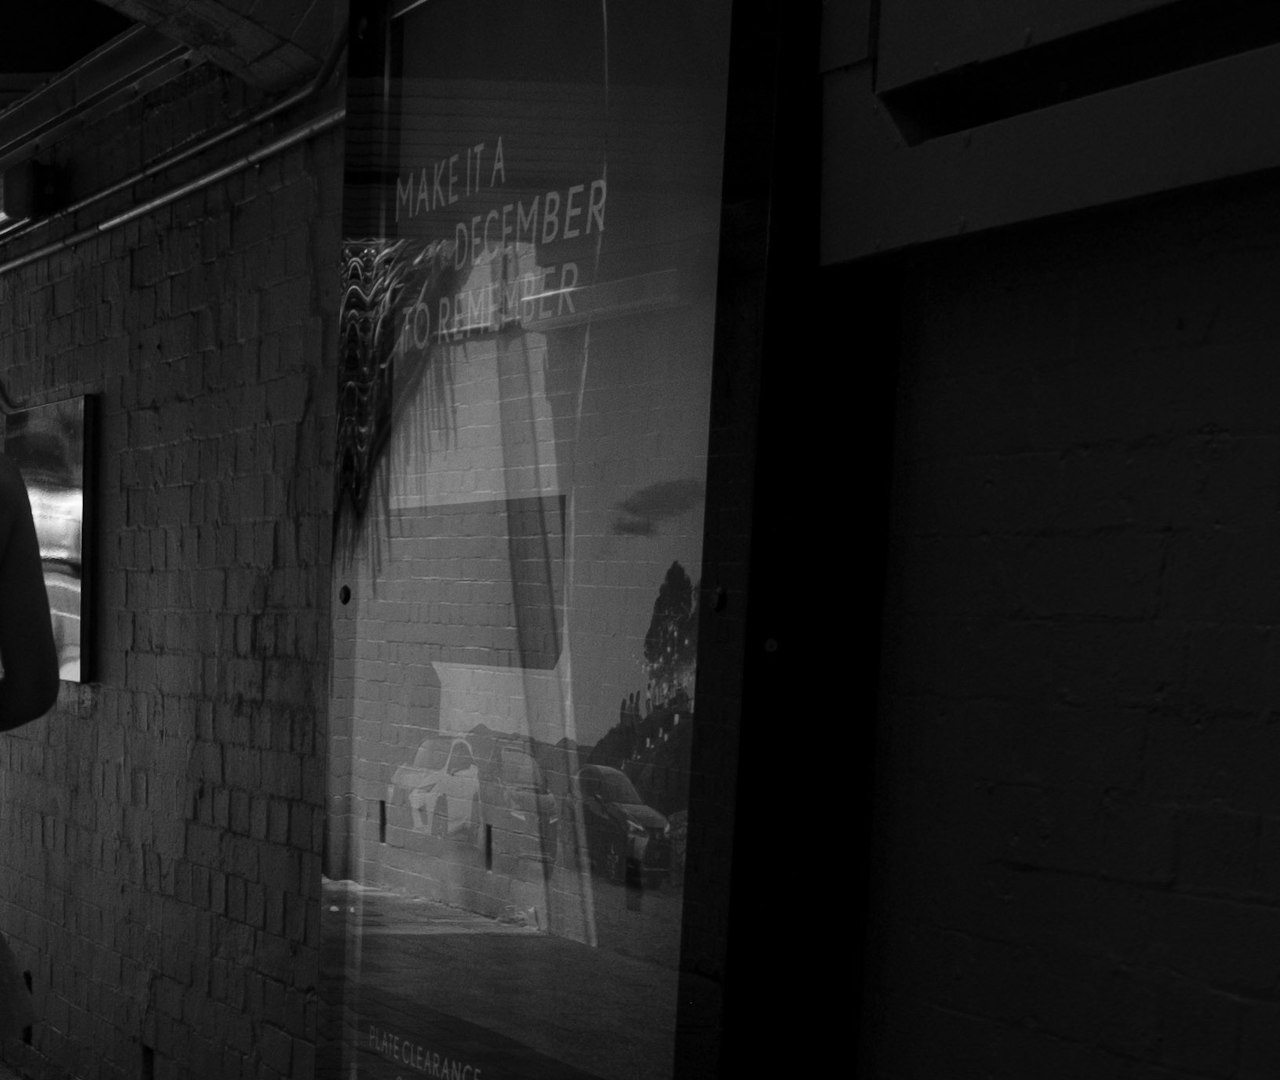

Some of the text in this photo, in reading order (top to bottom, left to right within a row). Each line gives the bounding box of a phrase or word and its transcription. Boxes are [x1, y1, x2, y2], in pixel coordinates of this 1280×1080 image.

[395, 135, 506, 223] MAKE IT A
[454, 179, 607, 272] DECEMBER
[401, 261, 579, 353] TO REMEMBER
[368, 1025, 400, 1060] PLATE
